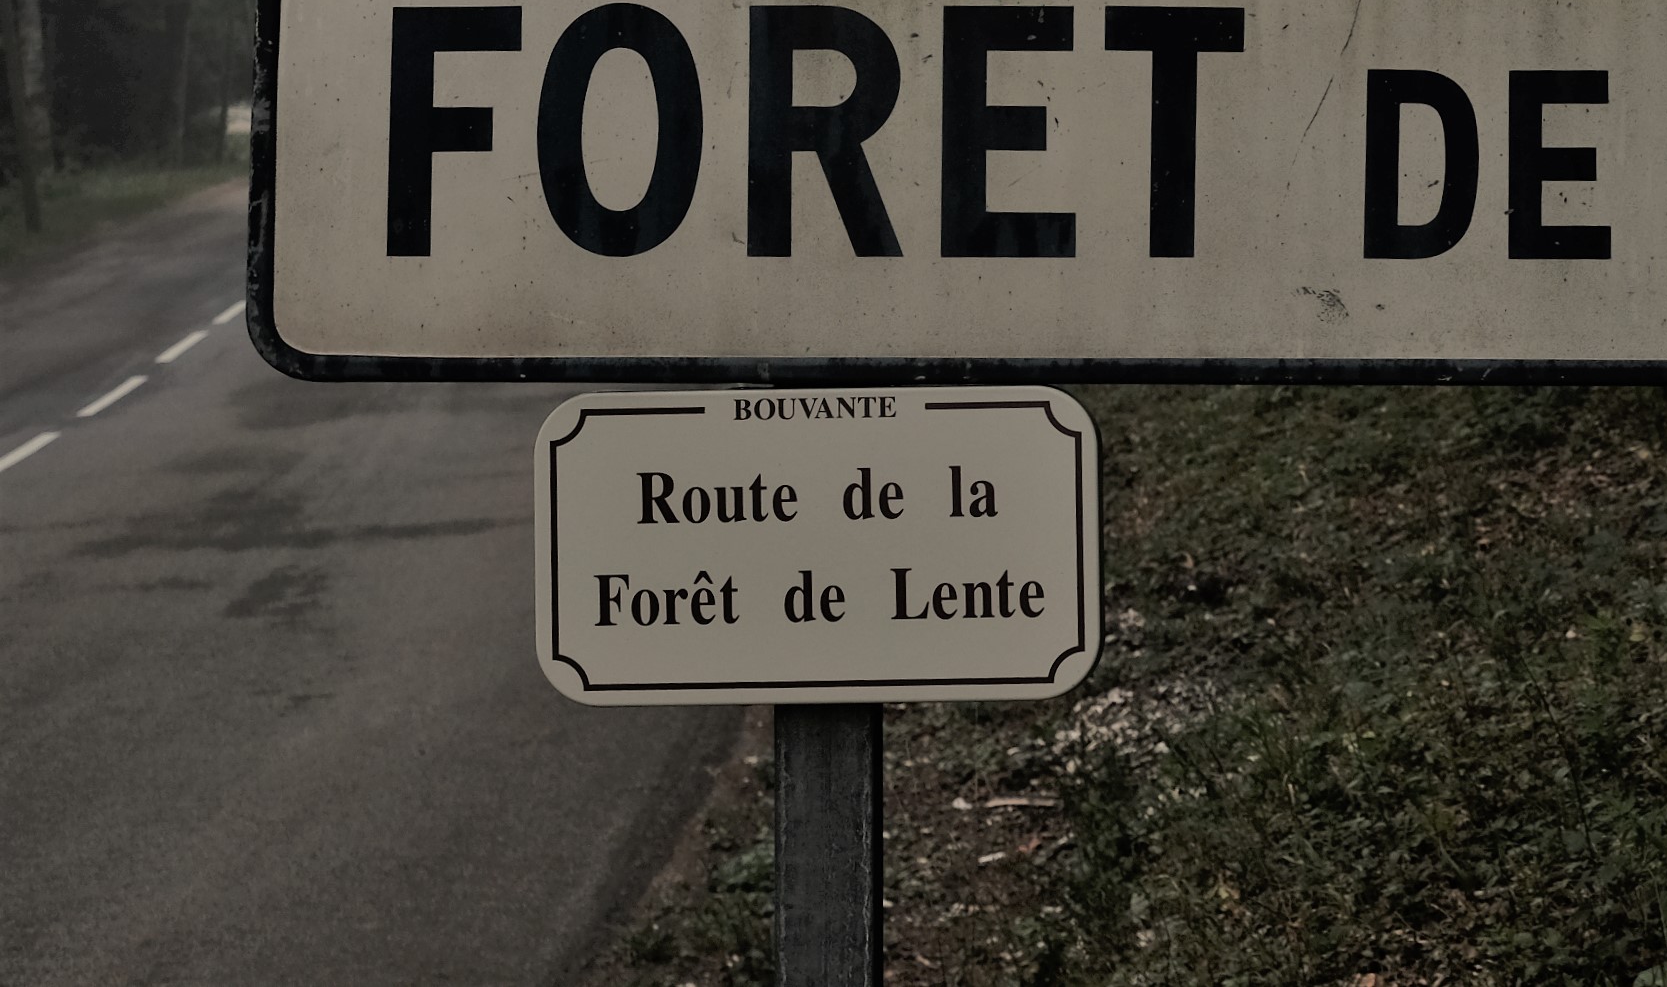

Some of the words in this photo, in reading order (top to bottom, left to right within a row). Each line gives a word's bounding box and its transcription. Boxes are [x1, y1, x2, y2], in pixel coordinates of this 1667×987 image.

[1363, 68, 1612, 260] DE
[733, 396, 897, 421] BOUVANTE
[636, 471, 799, 525] Route
[842, 467, 905, 521] de
[948, 465, 999, 518] la
[593, 570, 740, 627] Forêt
[783, 569, 846, 623] de
[889, 567, 1045, 620] Lente
